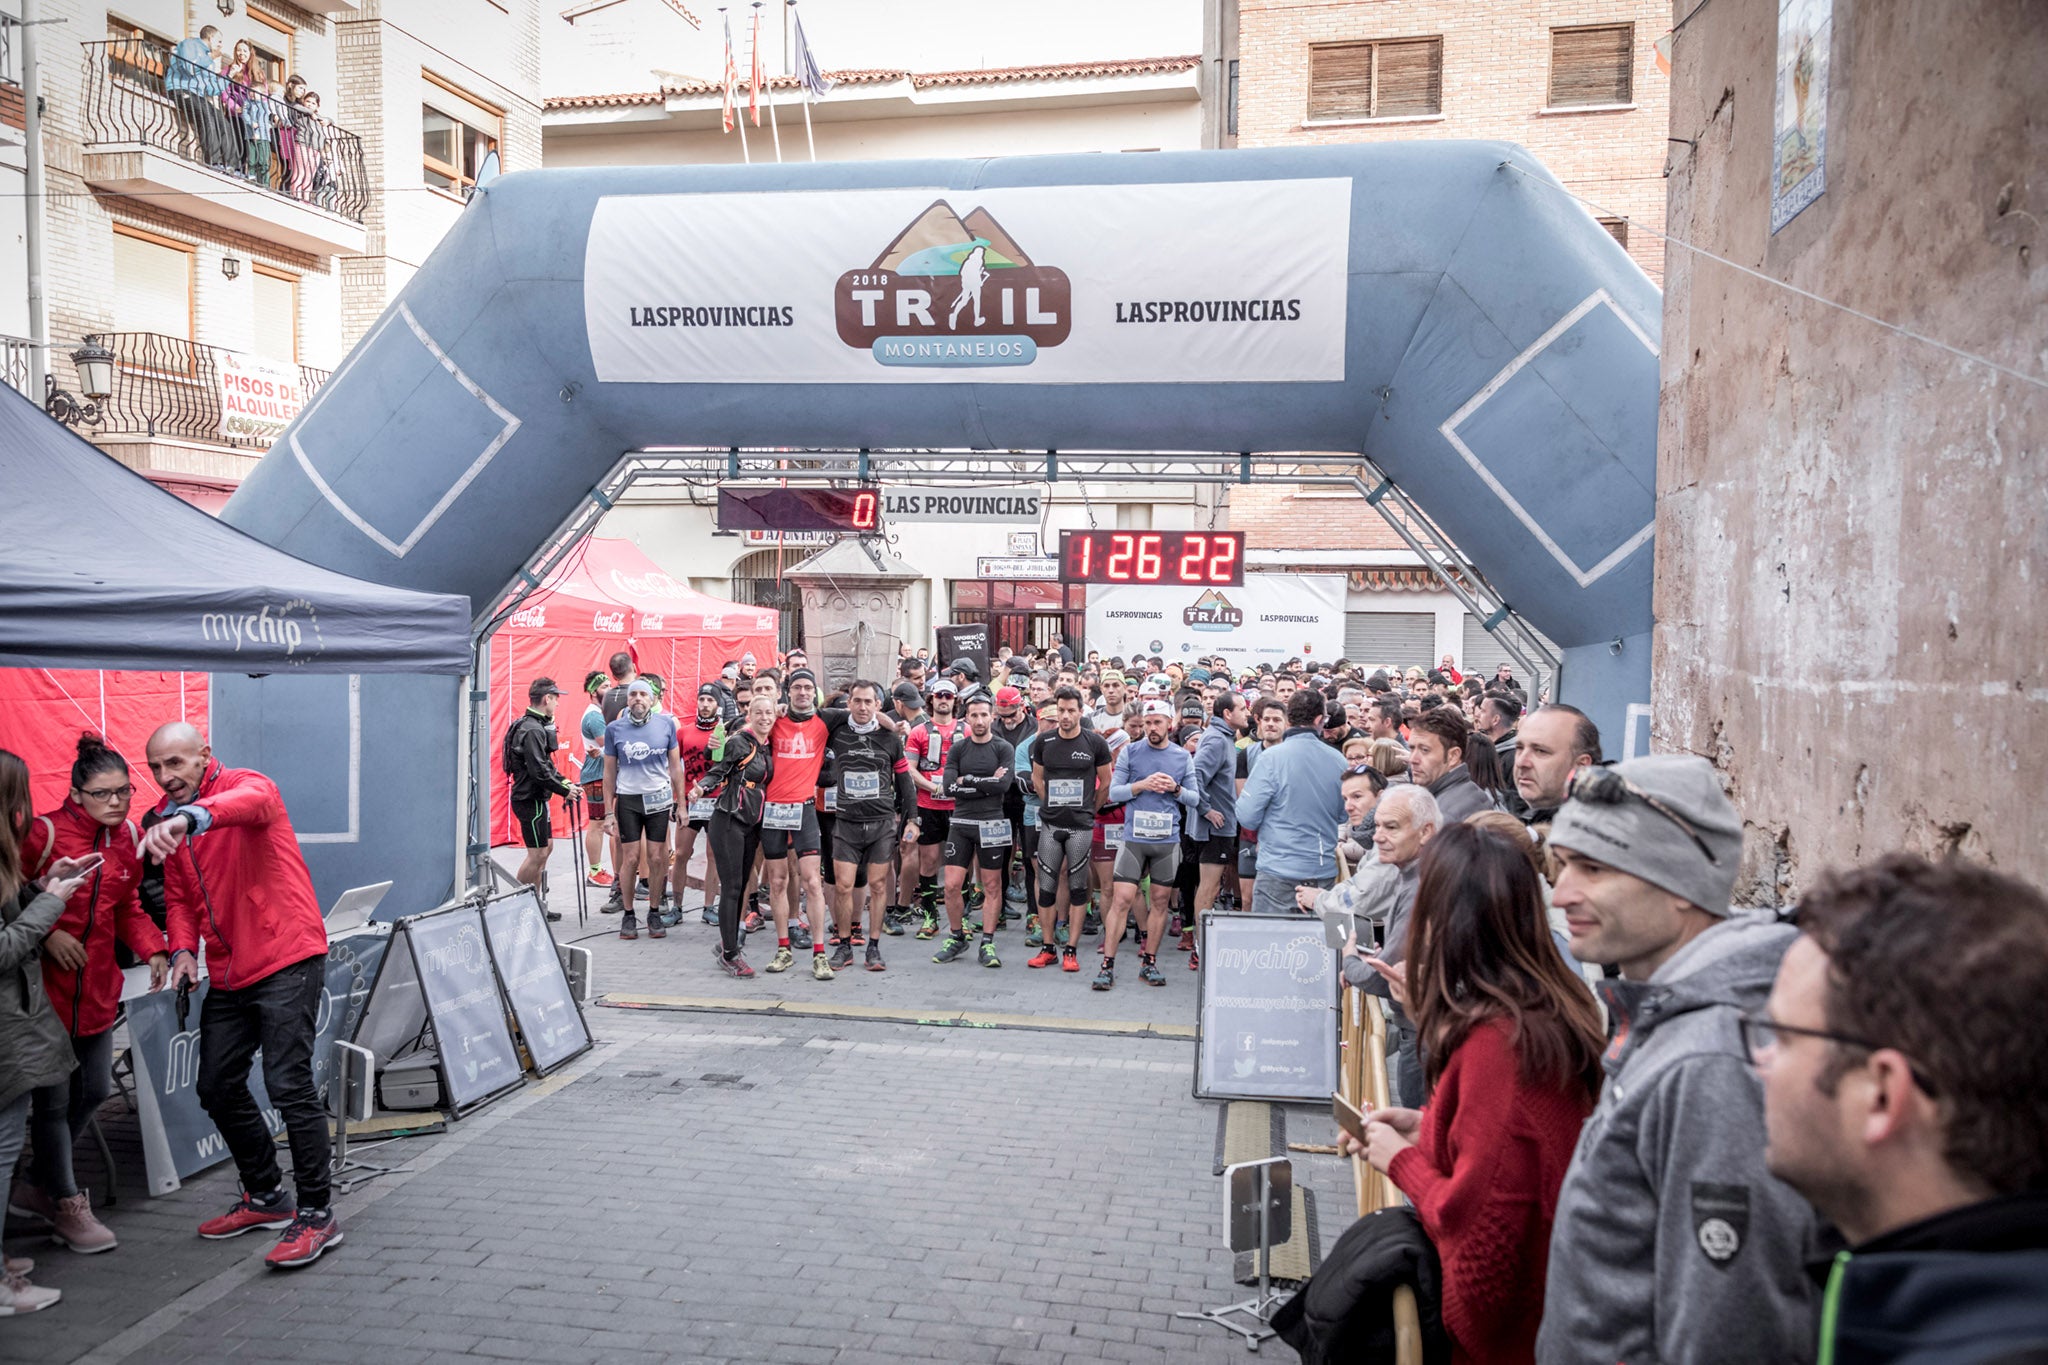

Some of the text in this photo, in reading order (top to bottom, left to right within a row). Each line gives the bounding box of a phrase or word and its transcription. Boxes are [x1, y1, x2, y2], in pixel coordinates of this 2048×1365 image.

[852, 275, 888, 286] 2018
[630, 306, 794, 327] LASPROVINCIAS
[1115, 299, 1301, 323] LASPROVINCIAS
[885, 343, 1024, 357] MONTANEJOS
[224, 373, 300, 402] PISOS DE
[885, 496, 1039, 515] LAS PROVINCIAS
[1106, 610, 1163, 620] LASPROVINCIAS
[1260, 614, 1319, 624] LASPROVINCIAS
[202, 605, 302, 654] mychip
[851, 780, 871, 788] 1141
[1055, 787, 1075, 795] 1093
[1142, 820, 1164, 828] 1130
[1216, 942, 1309, 977] mychip
[1215, 995, 1327, 1012] www.mychip.es
